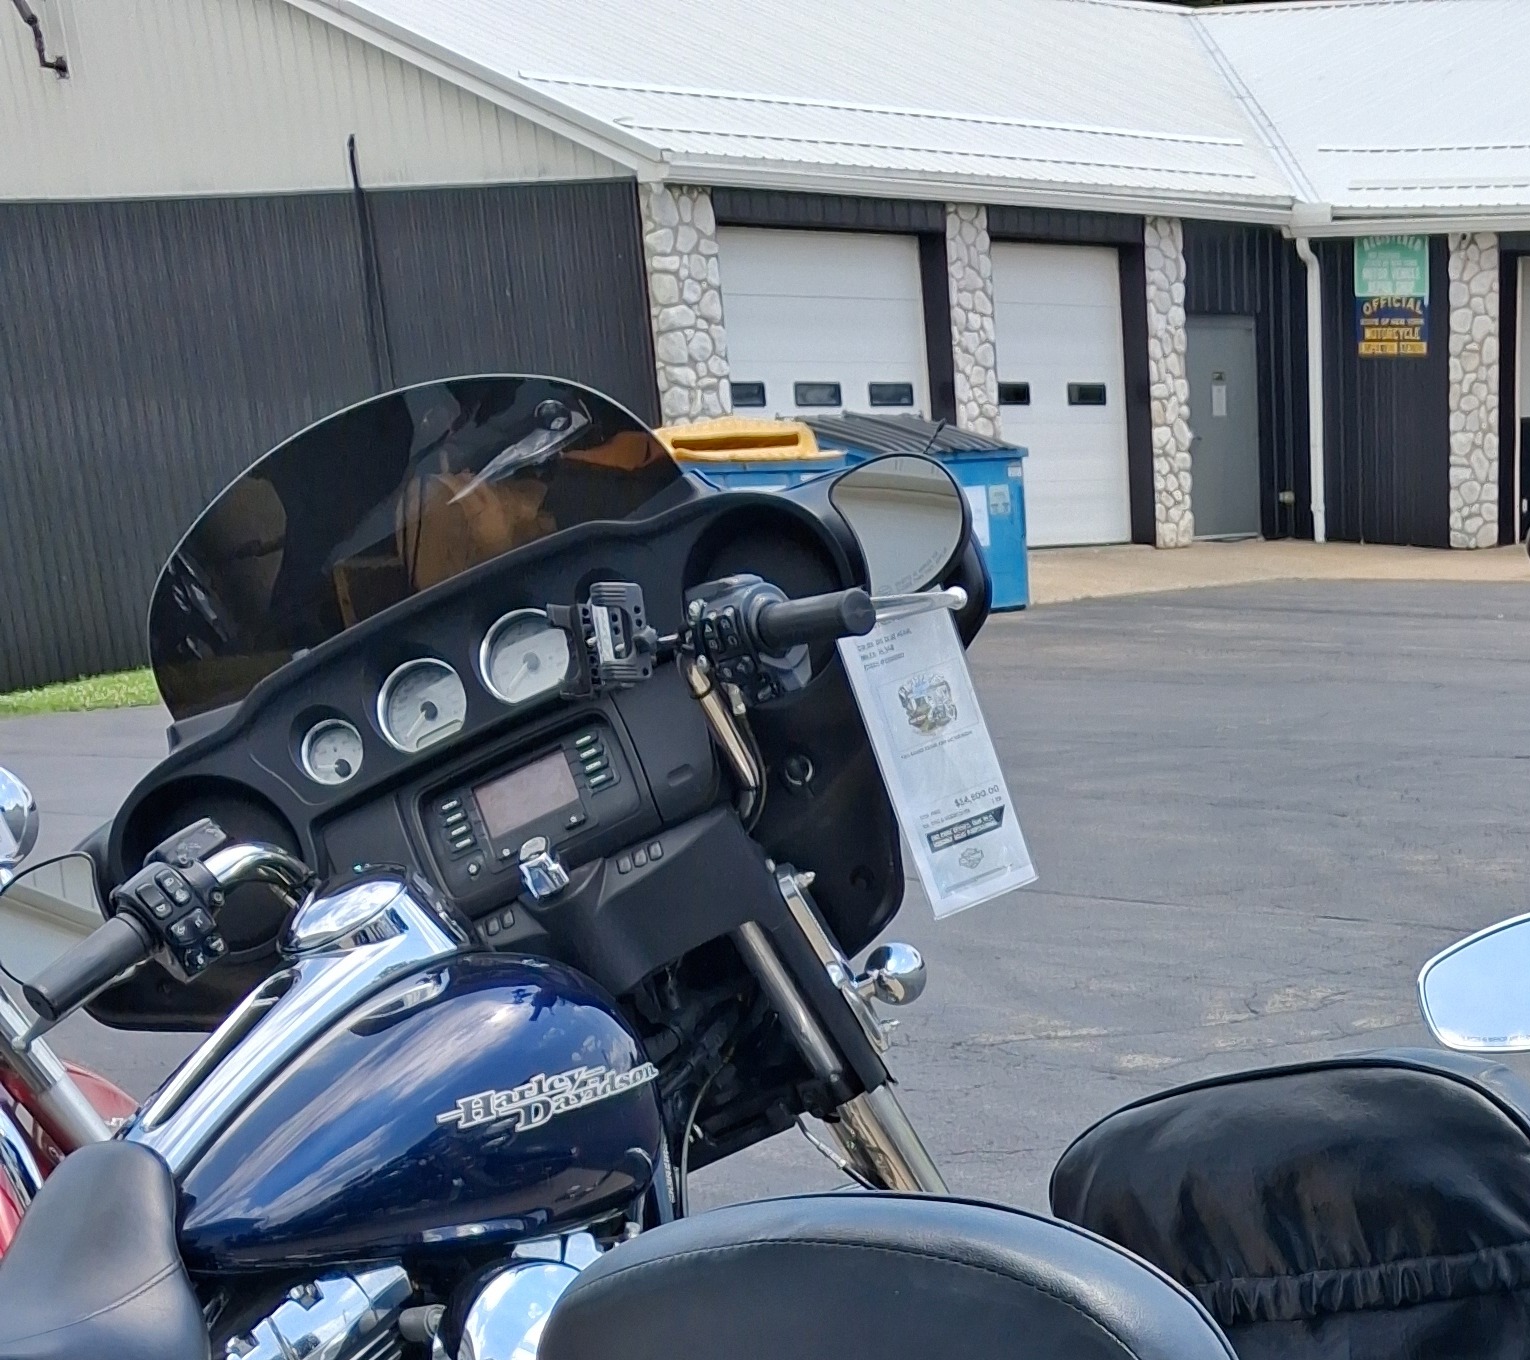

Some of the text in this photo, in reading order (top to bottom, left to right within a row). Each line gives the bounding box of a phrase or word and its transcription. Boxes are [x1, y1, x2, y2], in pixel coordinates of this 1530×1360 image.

[1363, 297, 1423, 315] OFFICIAL
[452, 1065, 594, 1130] Harley
[514, 1062, 660, 1132] Davidson
